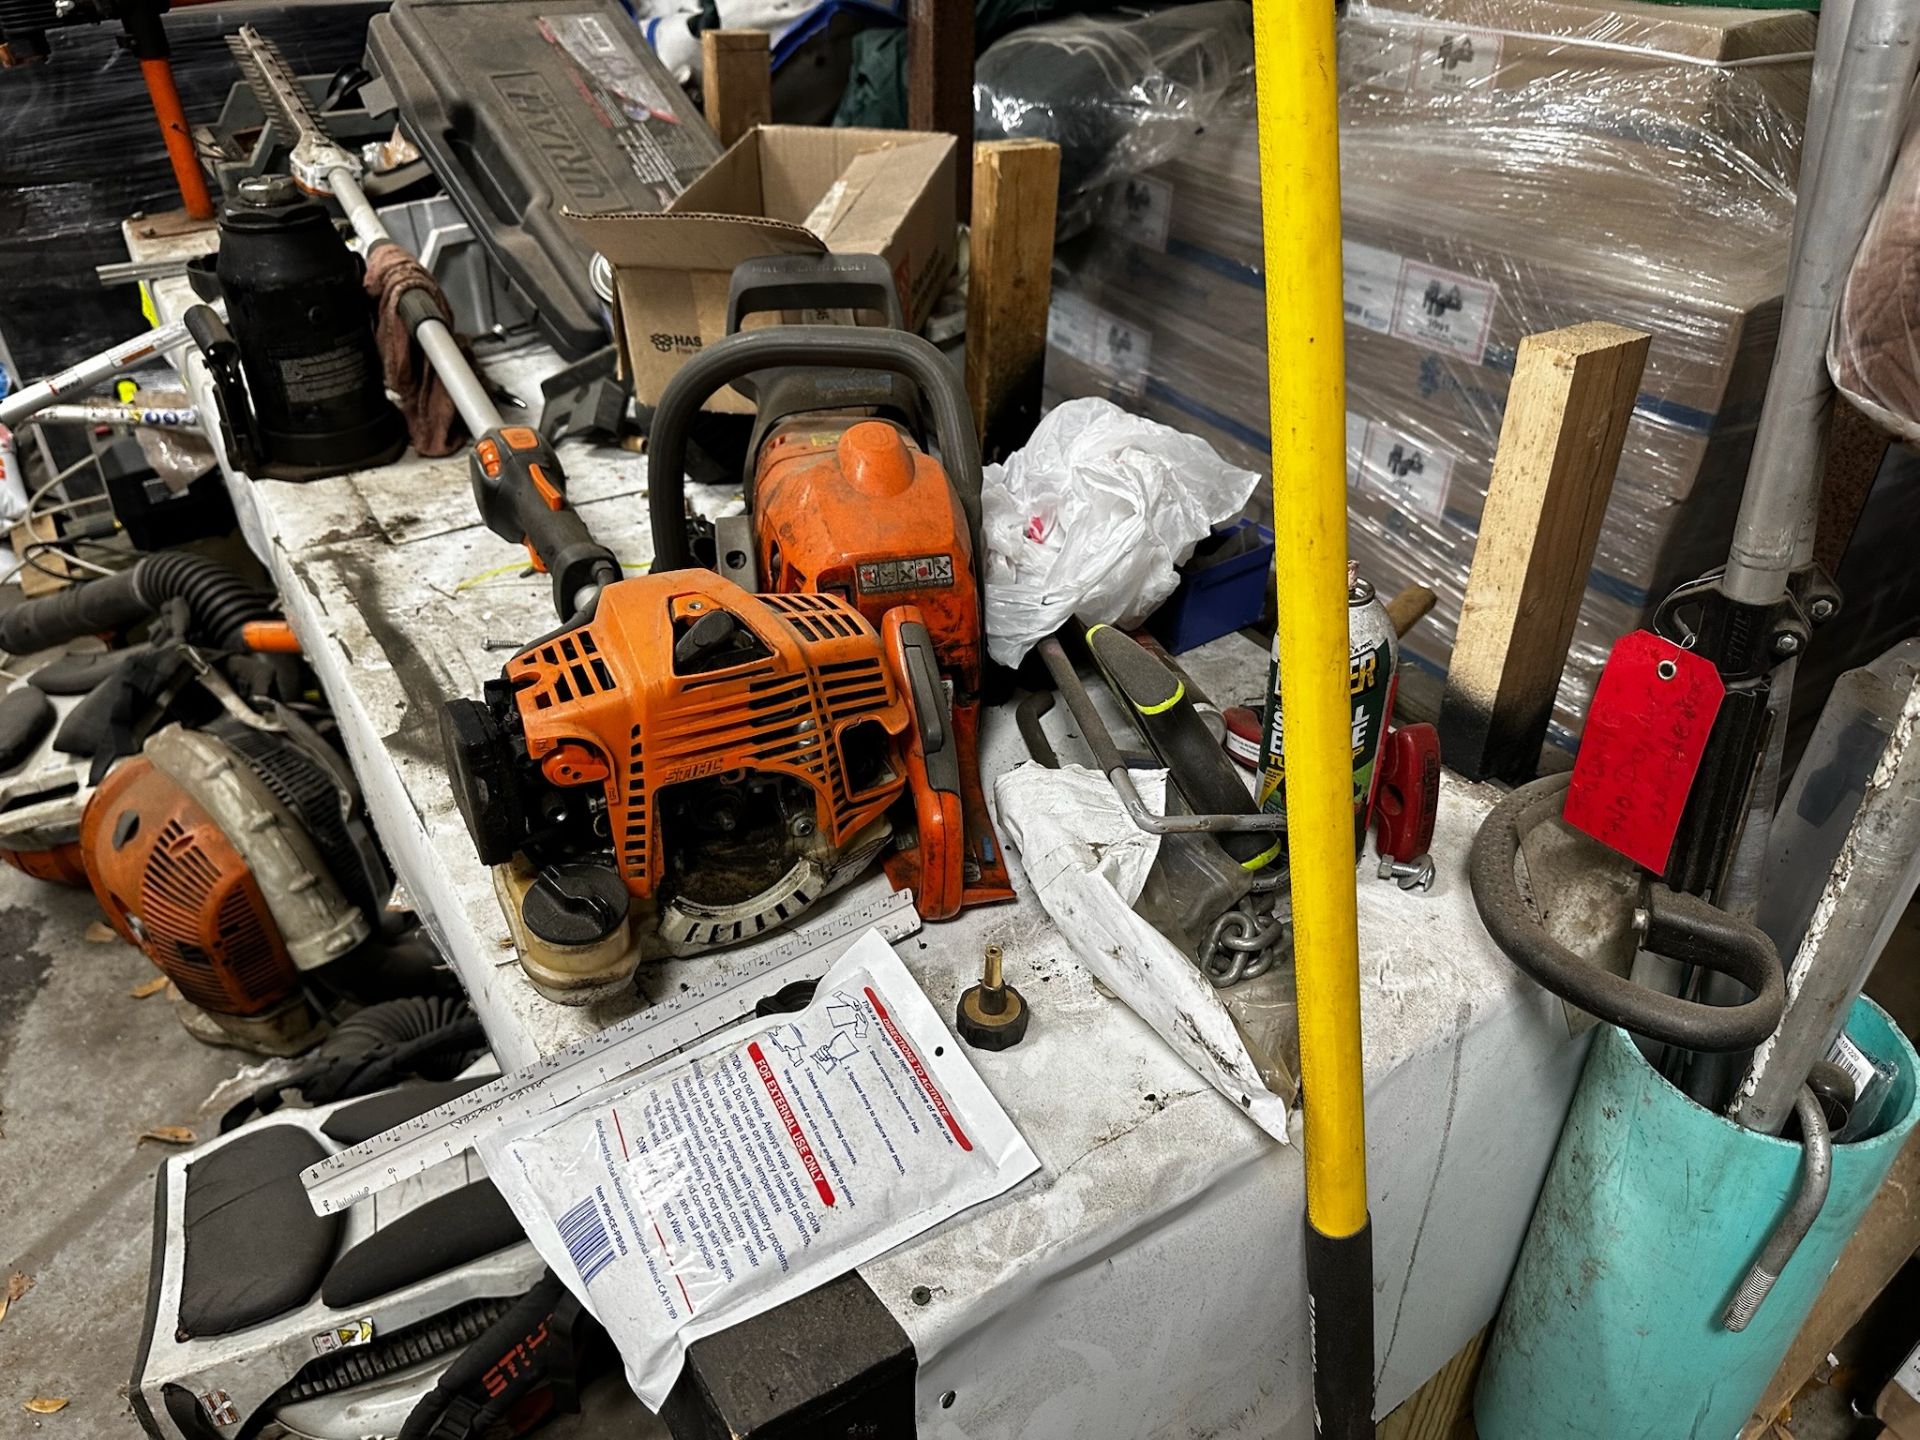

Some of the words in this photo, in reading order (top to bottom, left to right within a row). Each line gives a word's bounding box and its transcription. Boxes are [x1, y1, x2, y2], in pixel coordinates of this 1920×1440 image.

[508, 91, 605, 199] URIAH
[665, 758, 722, 783] STIHL
[868, 1049, 882, 1066] Shake
[881, 1016, 916, 1064] DIRECTIONS
[913, 1063, 924, 1076] TO
[919, 1075, 950, 1118] ACTIVATE
[737, 1070, 749, 1083] Do
[781, 1068, 794, 1084] Wrap
[845, 1070, 864, 1095] Squeeze
[861, 999, 874, 1014] This
[869, 1013, 876, 1021] is
[875, 1026, 893, 1047] single
[889, 1045, 901, 1059] use
[897, 1058, 911, 1075] item.
[907, 1074, 930, 1104] Dispose
[925, 1102, 935, 1113] of
[930, 1111, 946, 1130] after
[941, 1129, 955, 1146] use.
[877, 1065, 895, 1089] contents
[685, 1085, 697, 1098] out
[701, 1089, 711, 1099] to
[717, 1086, 727, 1096] to
[731, 1087, 744, 1101] Do
[742, 1082, 755, 1097] not
[789, 1082, 800, 1096] with
[704, 1097, 715, 1109] be
[719, 1094, 735, 1113] use,
[737, 1099, 750, 1114] not
[749, 1095, 767, 1121] reuse.
[795, 1095, 808, 1112] towel
[858, 1093, 873, 1111] firmly
[895, 1095, 910, 1115] bottom
[693, 1103, 710, 1126] reach
[728, 1111, 745, 1133] store
[743, 1113, 756, 1130] use
[755, 1058, 773, 1080] FOR
[764, 1079, 799, 1132] EXTERNAL
[790, 1130, 809, 1155] USE
[802, 1153, 824, 1184] ONLY
[803, 1111, 811, 1119] or
[868, 1109, 876, 1117] to
[906, 1114, 915, 1122] of
[703, 1124, 714, 1135] of
[717, 1127, 730, 1140] by
[759, 1119, 782, 1150] Always
[807, 1118, 818, 1131] soft
[813, 1088, 835, 1119] vigorously
[828, 1117, 845, 1139] mixing
[839, 1137, 859, 1166] contents.
[870, 1116, 888, 1139] rupture
[909, 1120, 922, 1135] bag.
[590, 1117, 613, 1155] Manufactured
[738, 1131, 749, 1143] at
[751, 1129, 762, 1142] on
[813, 1130, 826, 1148] cover
[883, 1137, 896, 1154] inner
[603, 1152, 613, 1162] for
[678, 1136, 707, 1184] mmediately.
[682, 1111, 707, 1153] swallowed,
[701, 1152, 721, 1183] contact
[713, 1182, 733, 1212] poison
[722, 1138, 745, 1172] persons
[743, 1141, 759, 1164] room
[755, 1140, 777, 1174] sensory
[772, 1149, 790, 1172] wrap
[821, 1146, 833, 1160] and
[606, 1161, 618, 1178] Total
[784, 1169, 794, 1178] a
[826, 1158, 841, 1178] apply
[889, 1153, 908, 1177] pouch.
[700, 1182, 713, 1197] Do
[722, 1167, 744, 1201] Harmful
[738, 1170, 754, 1190] with
[751, 1162, 785, 1216] temperature.
[788, 1176, 806, 1201] towel
[836, 1176, 845, 1184] to
[594, 1184, 607, 1203] Item
[611, 1175, 631, 1211] Resources
[770, 1171, 796, 1211] impaired
[839, 1183, 857, 1209] patient.
[691, 1192, 713, 1230] contacts
[706, 1195, 720, 1212] not
[738, 1200, 747, 1208] if
[745, 1187, 774, 1233] circulatory
[799, 1200, 810, 1211] or
[626, 1209, 650, 1255] International
[661, 1200, 675, 1219] and
[668, 1216, 688, 1247] Water.
[686, 1213, 699, 1231] call
[740, 1206, 769, 1254] swallowed.
[707, 1228, 722, 1249] skin
[691, 1229, 717, 1272] physician
[715, 1247, 725, 1259] or
[645, 1257, 662, 1285] Walnut
[718, 1257, 736, 1284] eyes,
[656, 1282, 668, 1298] CA
[661, 1295, 678, 1321] 91789
